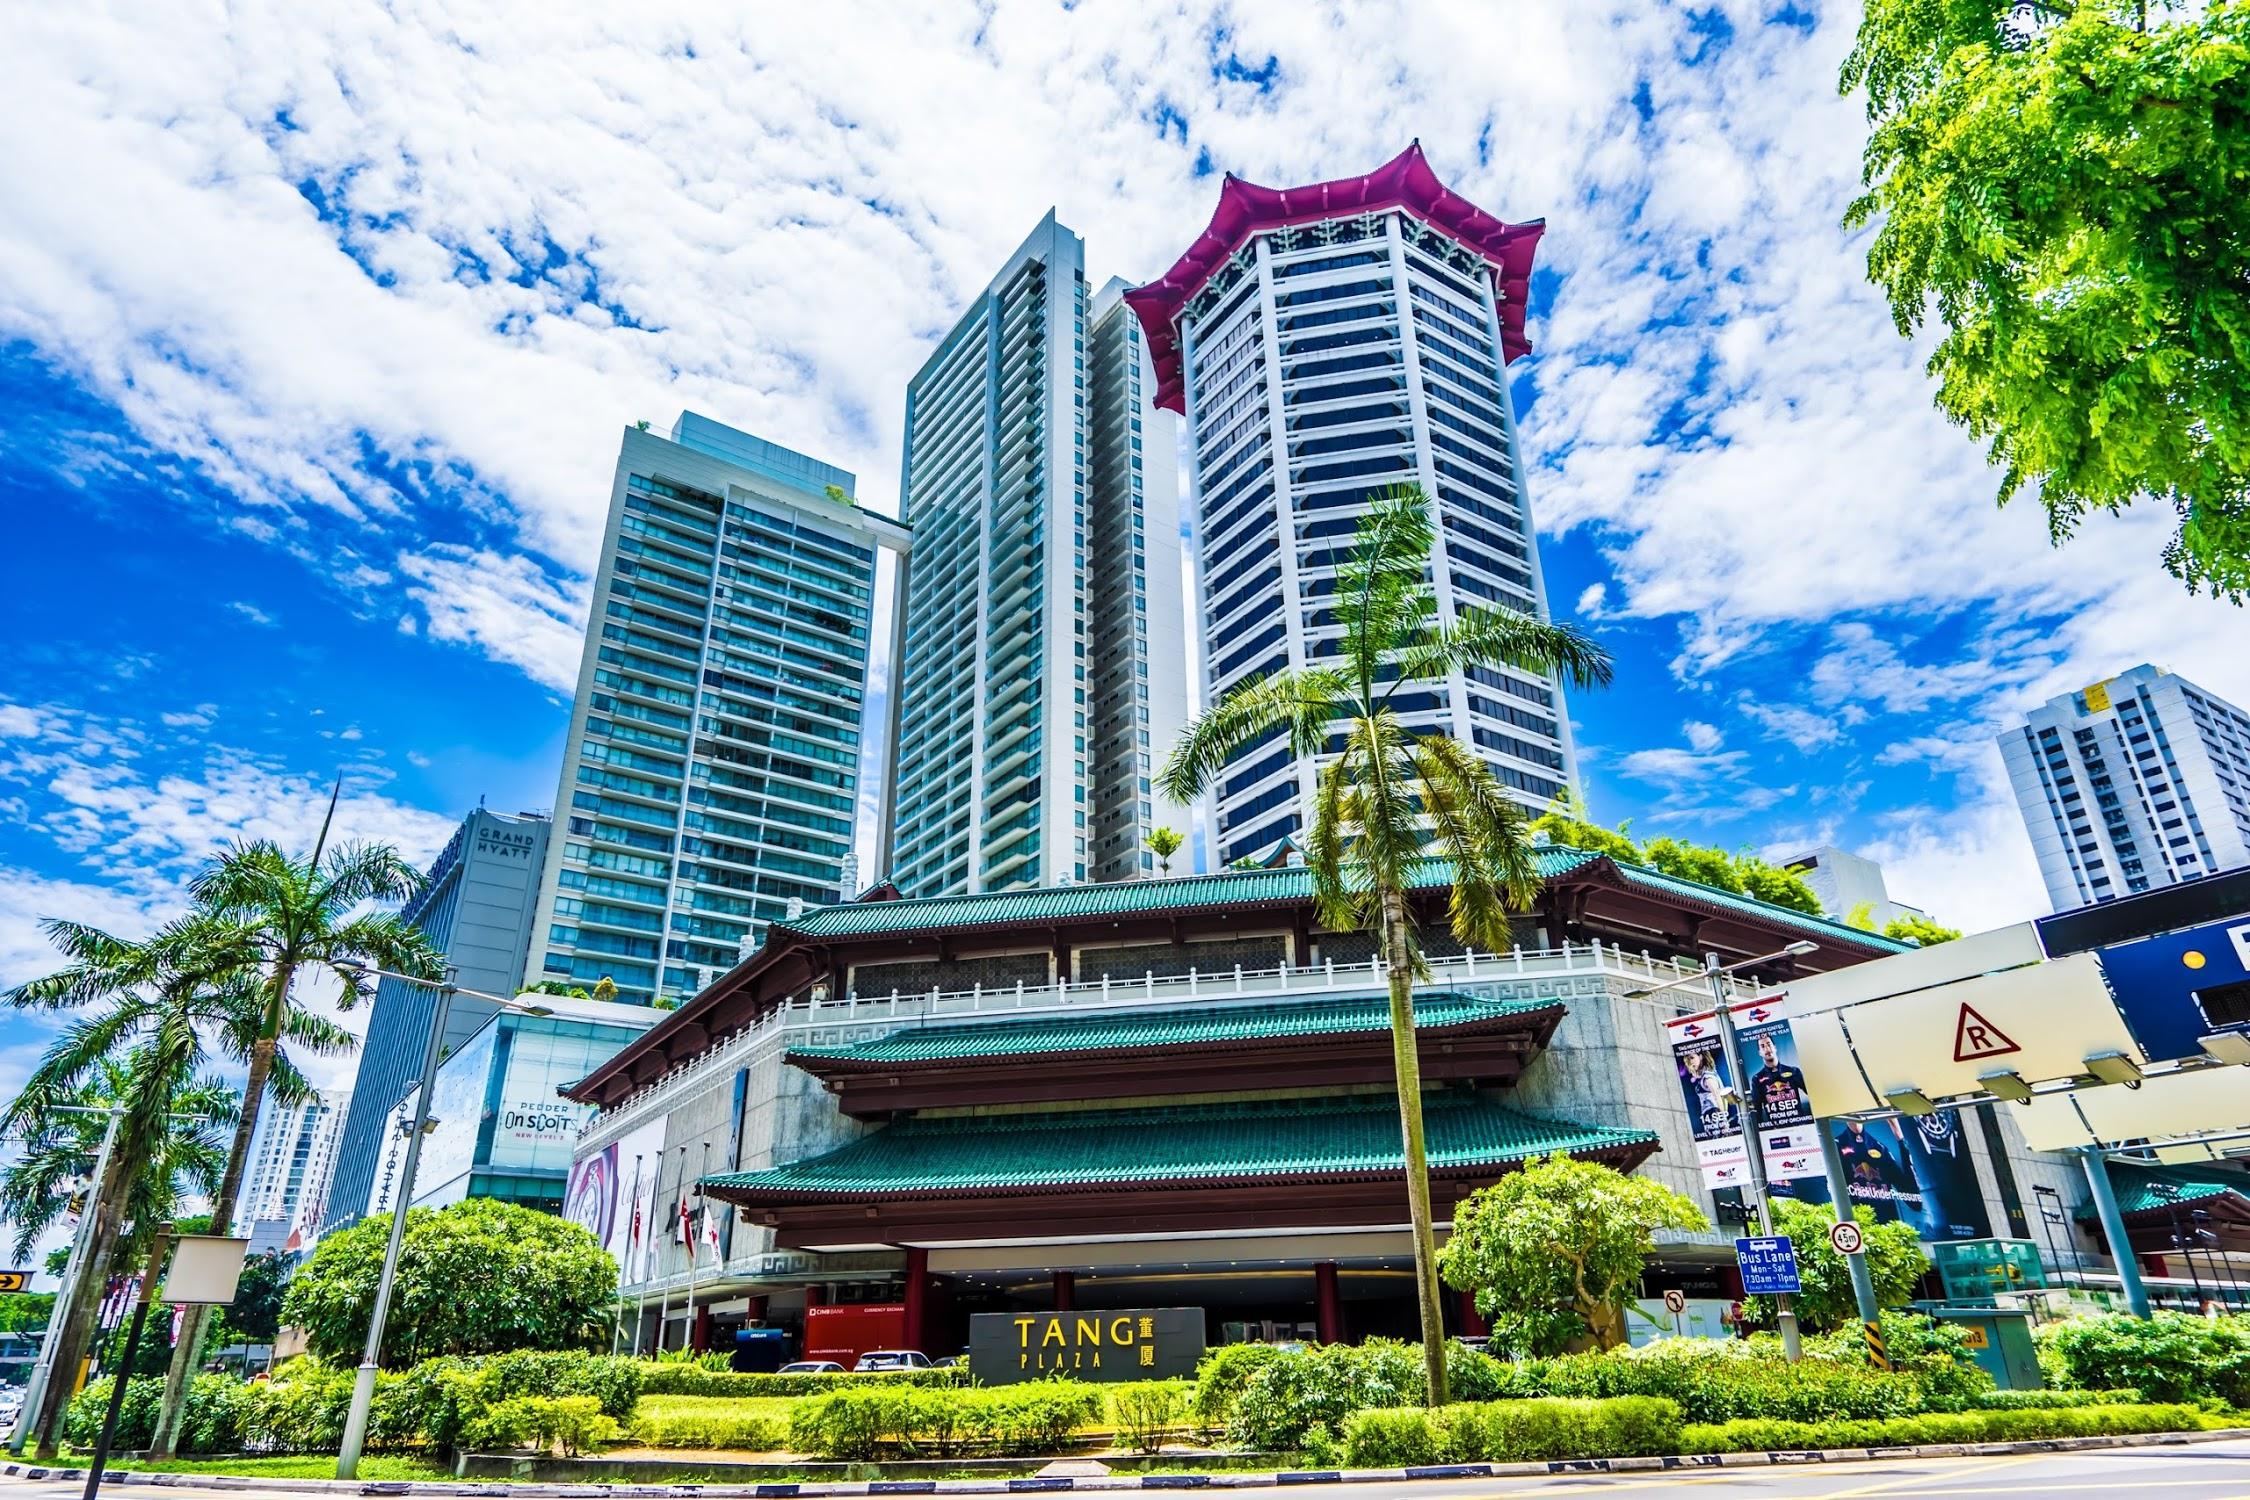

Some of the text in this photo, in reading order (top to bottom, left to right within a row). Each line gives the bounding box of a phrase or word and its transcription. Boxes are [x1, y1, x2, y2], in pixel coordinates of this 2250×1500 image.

[480, 828, 533, 846] GRAND
[478, 842, 530, 860] HYATT
[1966, 1025, 1994, 1050] R
[520, 1102, 569, 1113] PEDDER
[1765, 1099, 1799, 1113] 14 SEP
[1700, 1111, 1729, 1124] 14 SEP
[1847, 1184, 1922, 1202] CrackUnderPressure
[1838, 1233, 1856, 1243] 45m
[1740, 1250, 1792, 1264] Bus Lane
[1014, 1317, 1133, 1348] TANG
[1020, 1352, 1100, 1369] PLAZA
